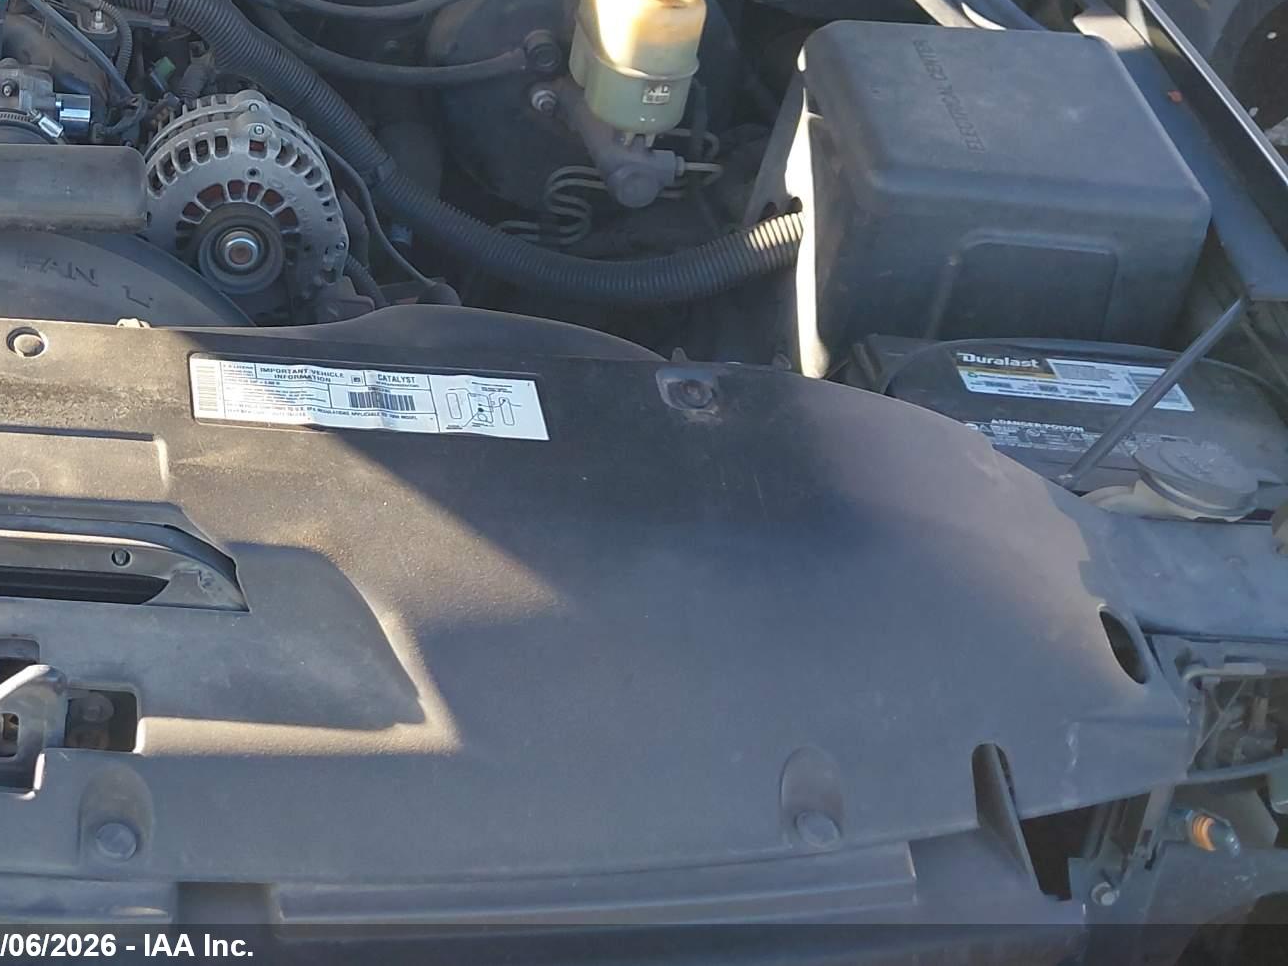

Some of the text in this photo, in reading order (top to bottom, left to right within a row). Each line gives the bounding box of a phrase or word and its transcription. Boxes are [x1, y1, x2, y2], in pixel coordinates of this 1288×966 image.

[19, 248, 102, 288] FAN
[958, 352, 1039, 369] Duralast
[260, 367, 309, 376] IMPORTANT
[310, 370, 345, 379] VEHICLE
[274, 374, 332, 383] INFORMATION
[377, 374, 416, 384] CATALYST
